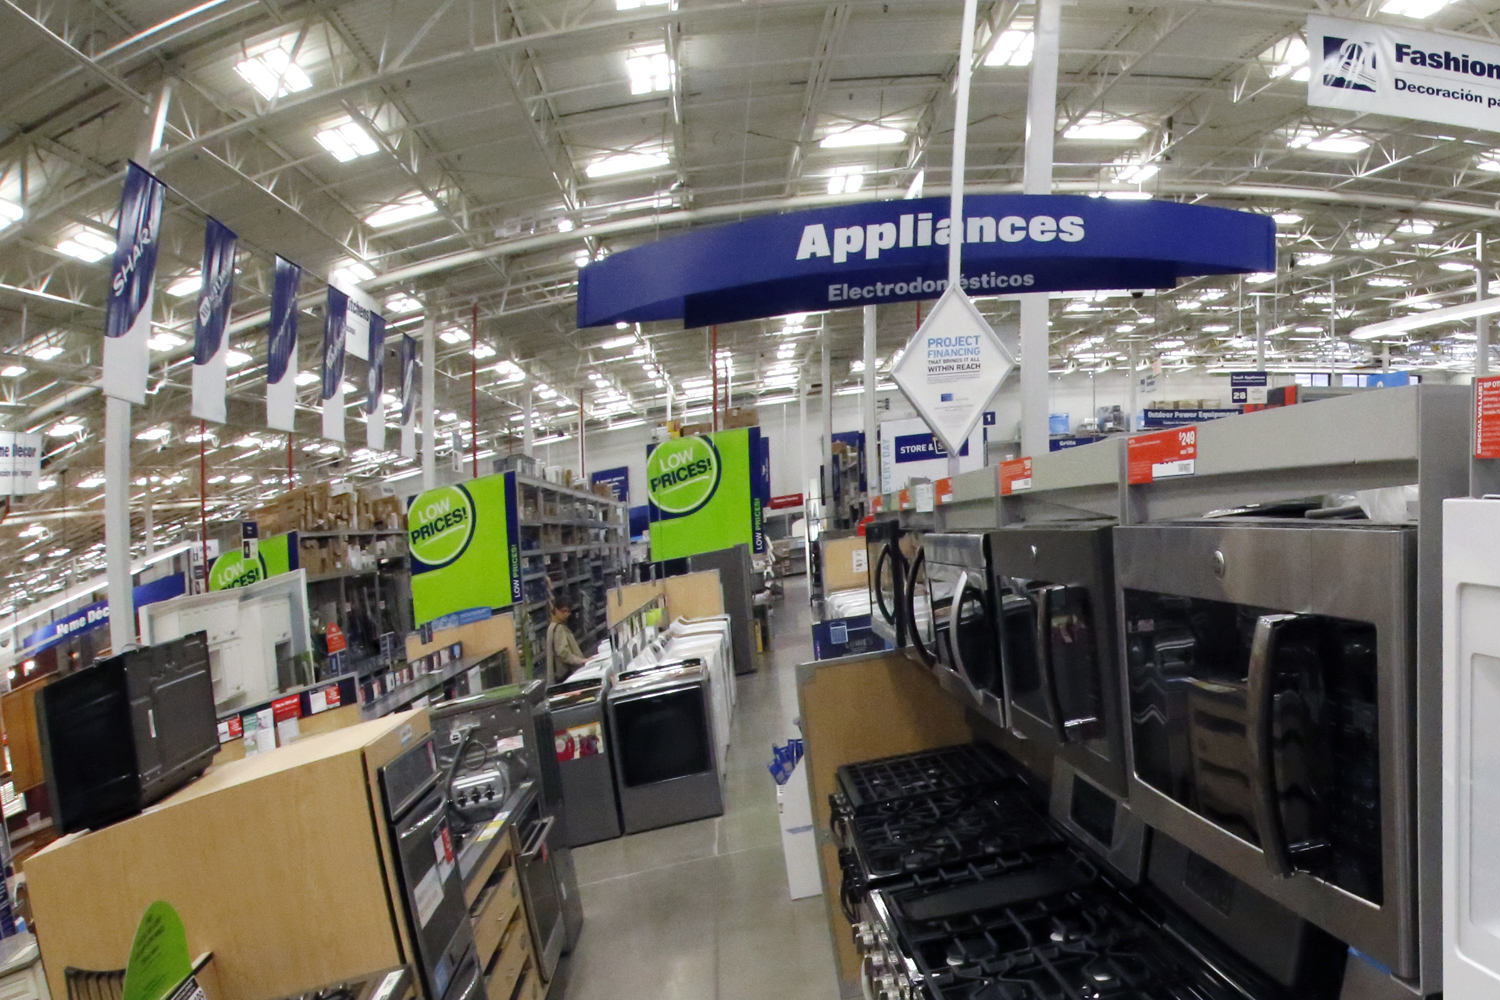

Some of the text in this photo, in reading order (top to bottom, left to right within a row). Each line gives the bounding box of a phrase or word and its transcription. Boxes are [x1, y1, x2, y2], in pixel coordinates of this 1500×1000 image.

[1394, 78, 1483, 103] Decoración
[795, 213, 1085, 263] Appliances
[348, 299, 370, 321] itchens
[927, 335, 981, 348] PROJECT
[927, 347, 980, 358] FINANCING
[957, 363, 981, 371] REACH
[1233, 391, 1246, 399] 28
[900, 444, 927, 454] STORE
[1179, 431, 1195, 445] $249
[659, 447, 694, 473] LOW
[650, 458, 712, 493] PRICES!
[883, 467, 891, 493] EVERY
[418, 497, 450, 524] LOW
[410, 506, 468, 545] PRICES!
[753, 498, 763, 550] LOW PRICES!
[217, 561, 245, 586] LOW
[56, 604, 109, 636] Home Déc
